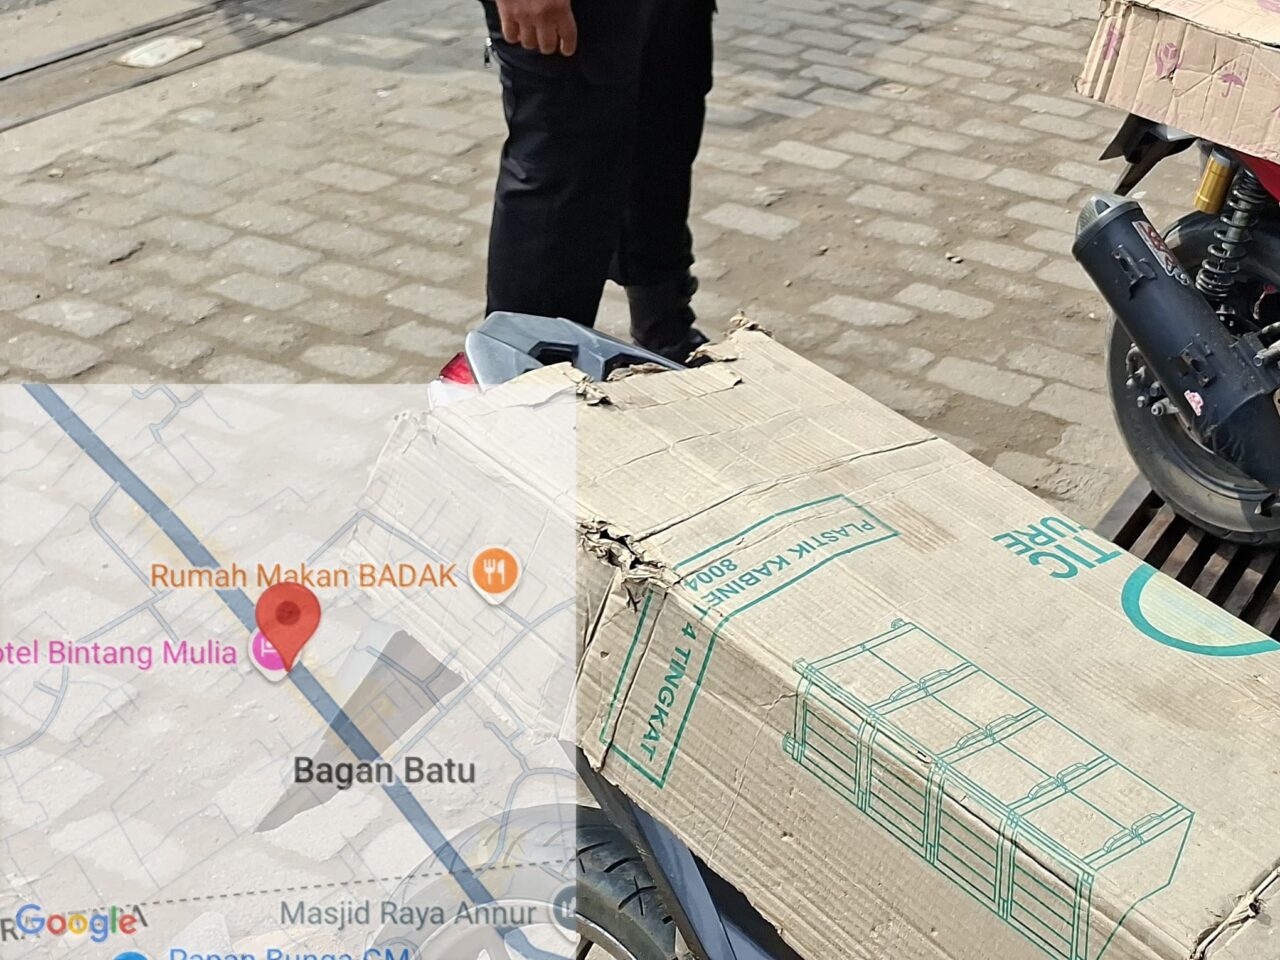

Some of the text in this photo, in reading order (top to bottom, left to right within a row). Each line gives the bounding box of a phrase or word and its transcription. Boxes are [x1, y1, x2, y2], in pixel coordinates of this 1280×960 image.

[682, 556, 739, 593] 8004
[691, 517, 877, 621] PLASTIK KABINET
[992, 515, 1088, 564] URE
[640, 646, 694, 762] TINGKAT
